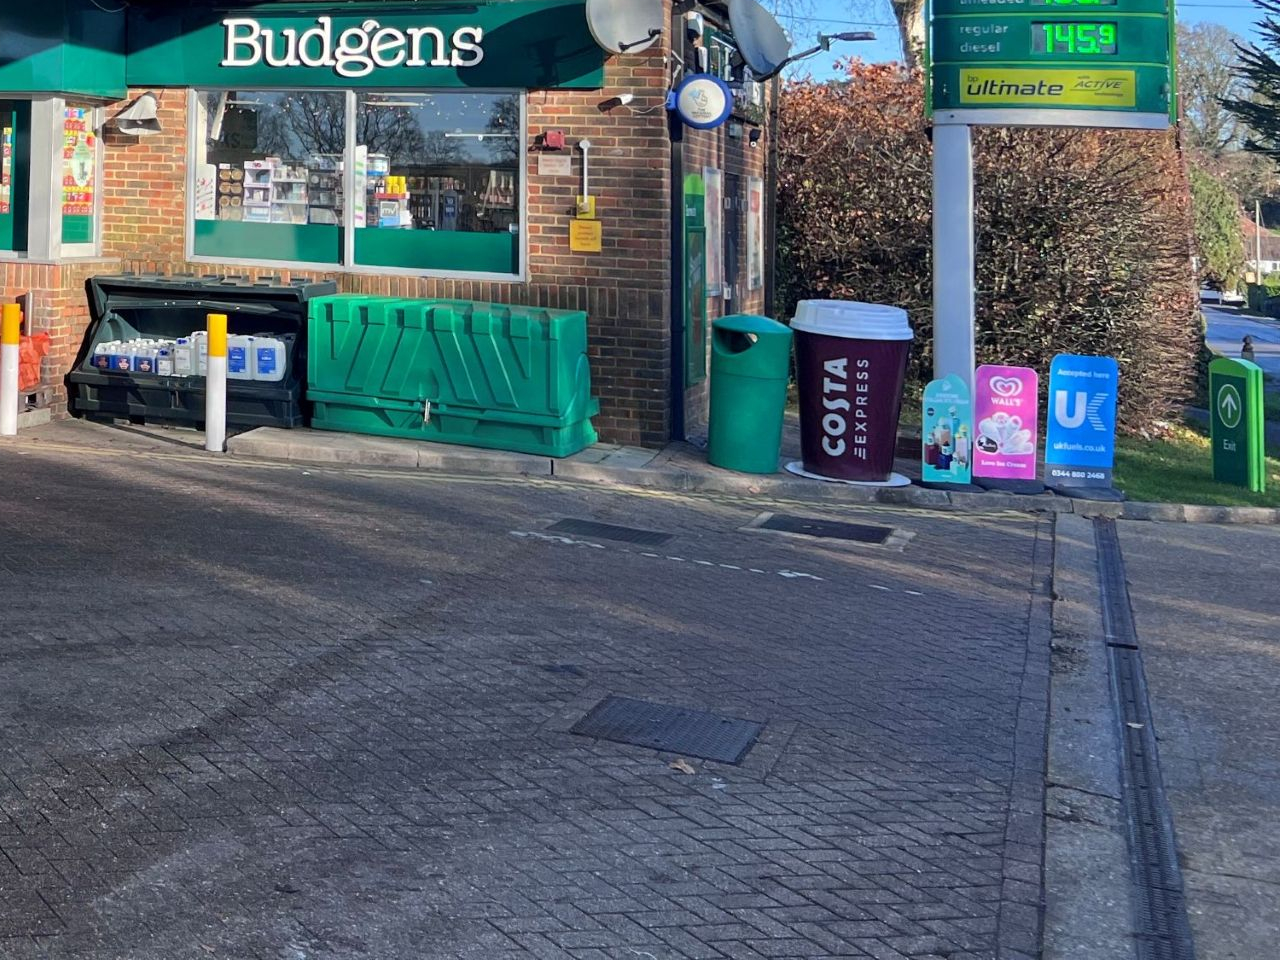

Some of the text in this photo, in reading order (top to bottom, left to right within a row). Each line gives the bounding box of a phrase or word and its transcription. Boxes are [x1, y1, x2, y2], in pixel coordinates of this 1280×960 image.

[960, 24, 1009, 36] regular
[221, 16, 484, 78] Budgens
[960, 41, 1001, 53] diesel
[967, 79, 1064, 97] ultimate
[1074, 80, 1123, 89] ACTIVE
[1057, 368, 1110, 379] Accepted here
[821, 357, 851, 457] COSTA
[854, 359, 869, 444] EXPRESS
[1053, 441, 1106, 453] ukfuels.co.uk
[1222, 439, 1237, 452] Exit
[1051, 469, 1070, 478] 0344
[1087, 471, 1105, 480] 2468
